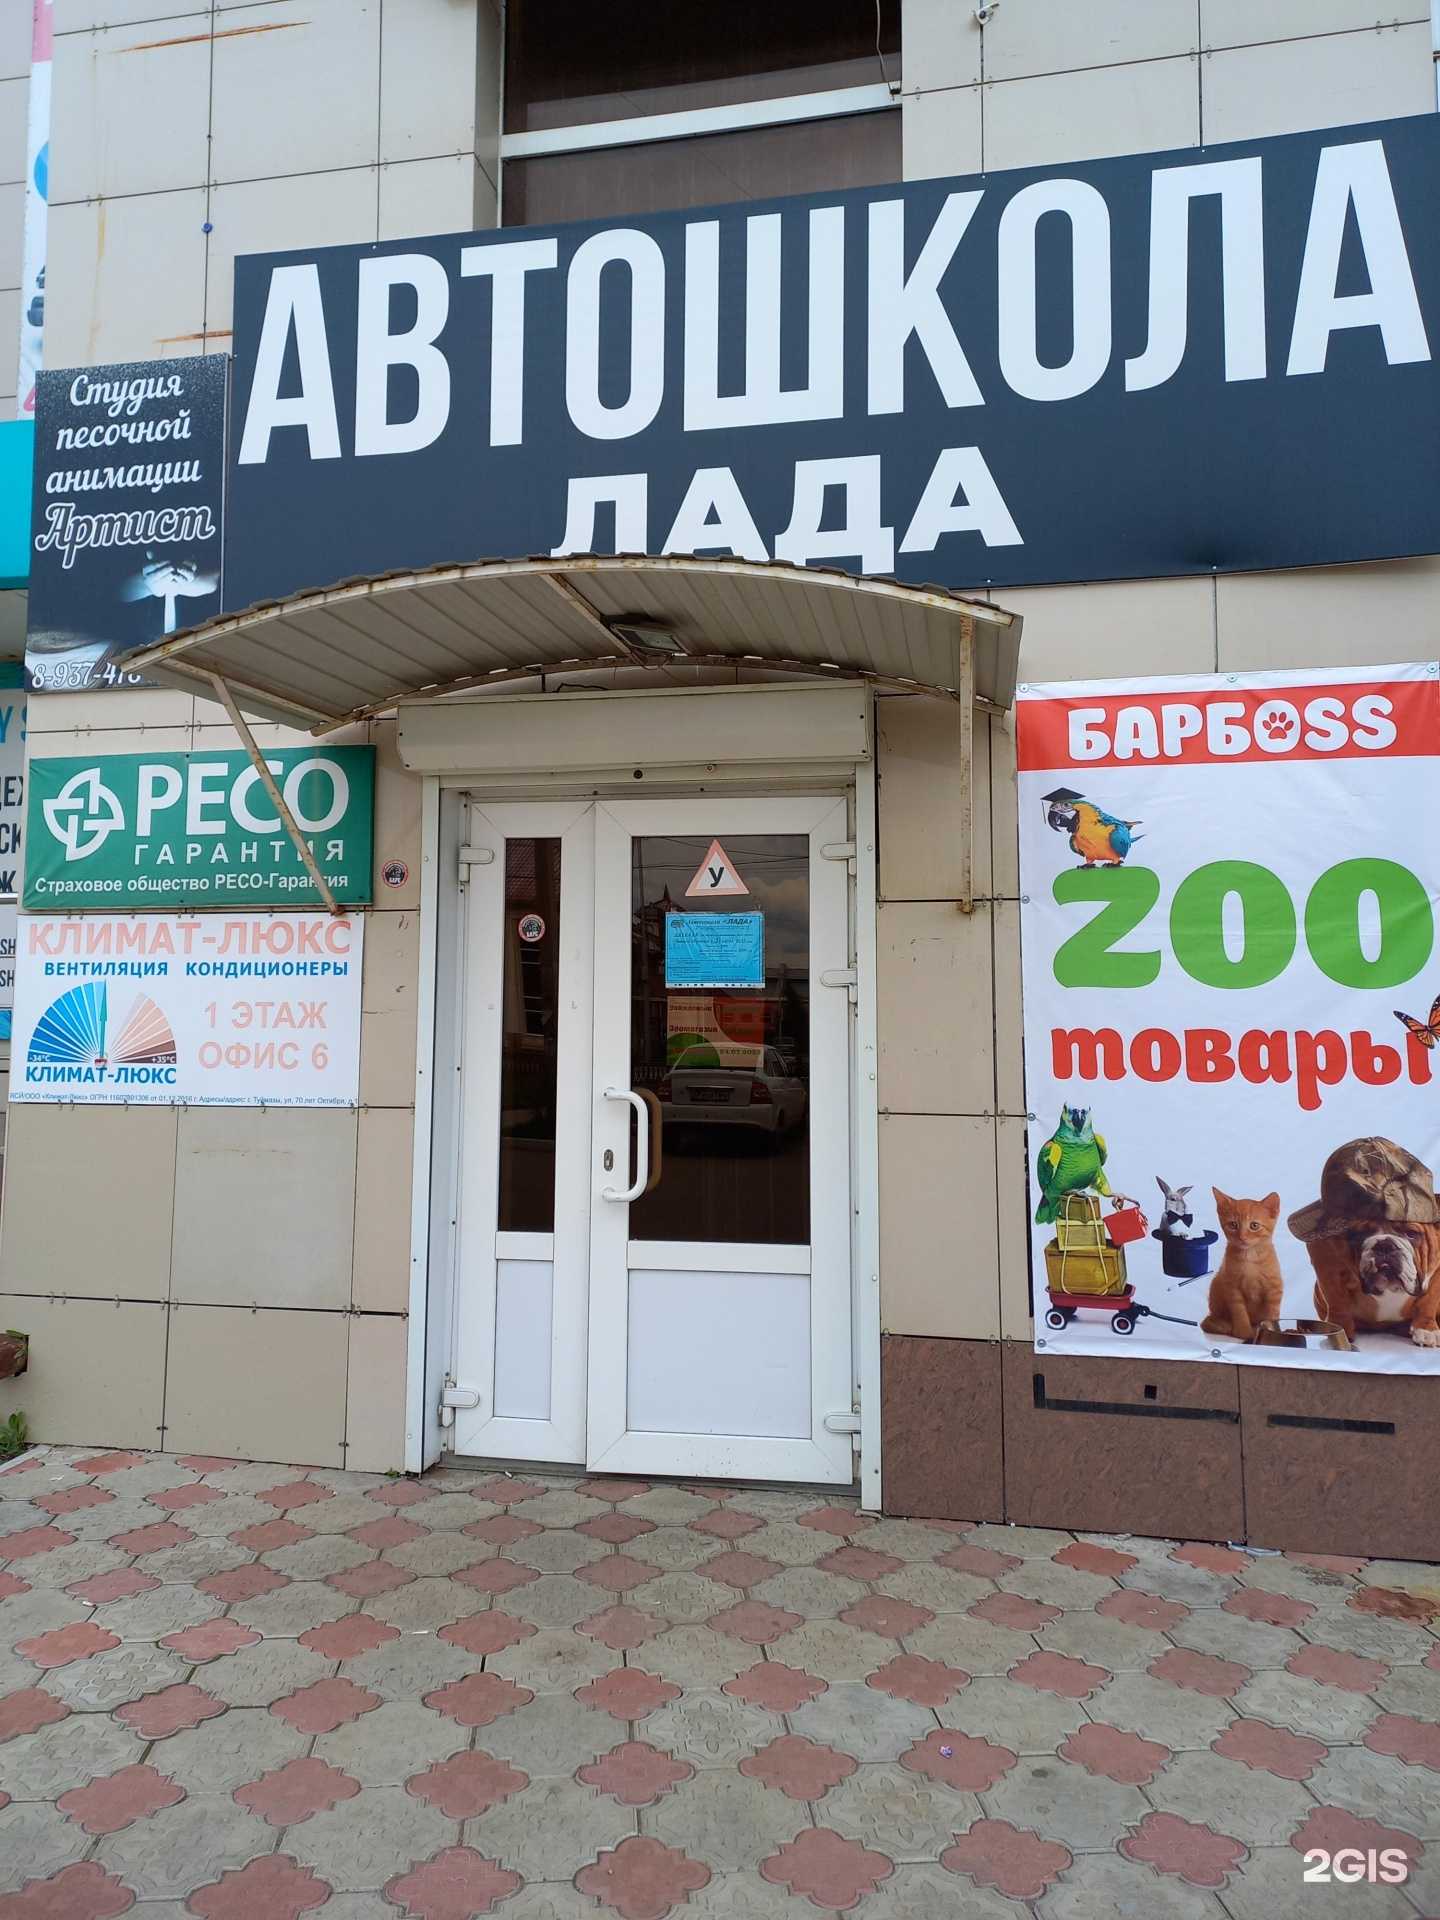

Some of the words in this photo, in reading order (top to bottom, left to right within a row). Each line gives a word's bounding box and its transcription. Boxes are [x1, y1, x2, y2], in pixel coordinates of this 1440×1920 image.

[238, 138, 1432, 465] АВТОШКОЛА
[70, 374, 184, 417] Студия
[56, 409, 192, 451] песочной
[45, 459, 203, 493] анимации
[550, 446, 1025, 575] ЛАДА
[34, 502, 216, 570] Артист
[136, 757, 350, 837] РЕСО
[35, 874, 123, 896] Страховое
[127, 875, 210, 893] общество
[29, 920, 352, 956] КЛИМАТ-ЛЮКС
[44, 962, 169, 977] ВЕНТИЛЯЦИЯ
[186, 962, 349, 979] КОНДИЦИОНЕРЫ
[204, 1002, 217, 1028] 1
[231, 1001, 327, 1029] ЭТАЖ
[26, 1066, 177, 1084] КЛИМАТ-ЛЮКС
[198, 1041, 300, 1070] ОФИС
[311, 1042, 329, 1070] 6
[1051, 1027, 1434, 1111] товары
